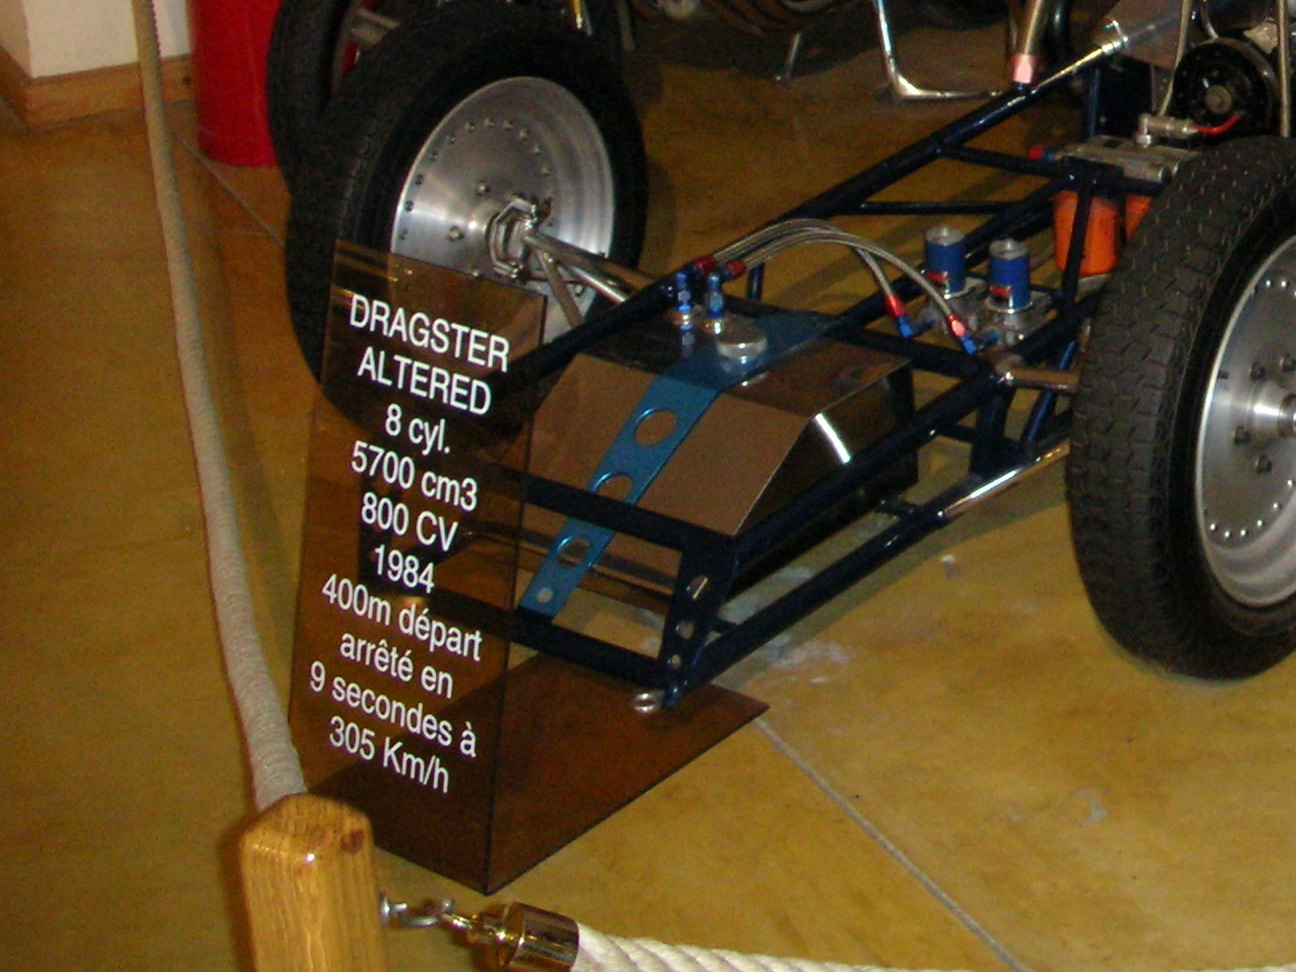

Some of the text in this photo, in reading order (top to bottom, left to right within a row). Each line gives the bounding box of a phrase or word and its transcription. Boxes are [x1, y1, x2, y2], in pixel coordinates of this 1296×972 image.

[350, 294, 510, 372] DRAGSTER
[357, 346, 492, 415] ALTERED
[385, 403, 450, 456] 8 cyl.
[351, 440, 477, 512] 5700 cm3
[361, 492, 458, 552] 800 CV
[374, 544, 434, 593] 1984
[322, 573, 482, 661] 400m départ
[340, 633, 453, 698] arrêté en
[310, 660, 476, 757] 9 secondes à
[329, 716, 449, 793] 305 Km/h
